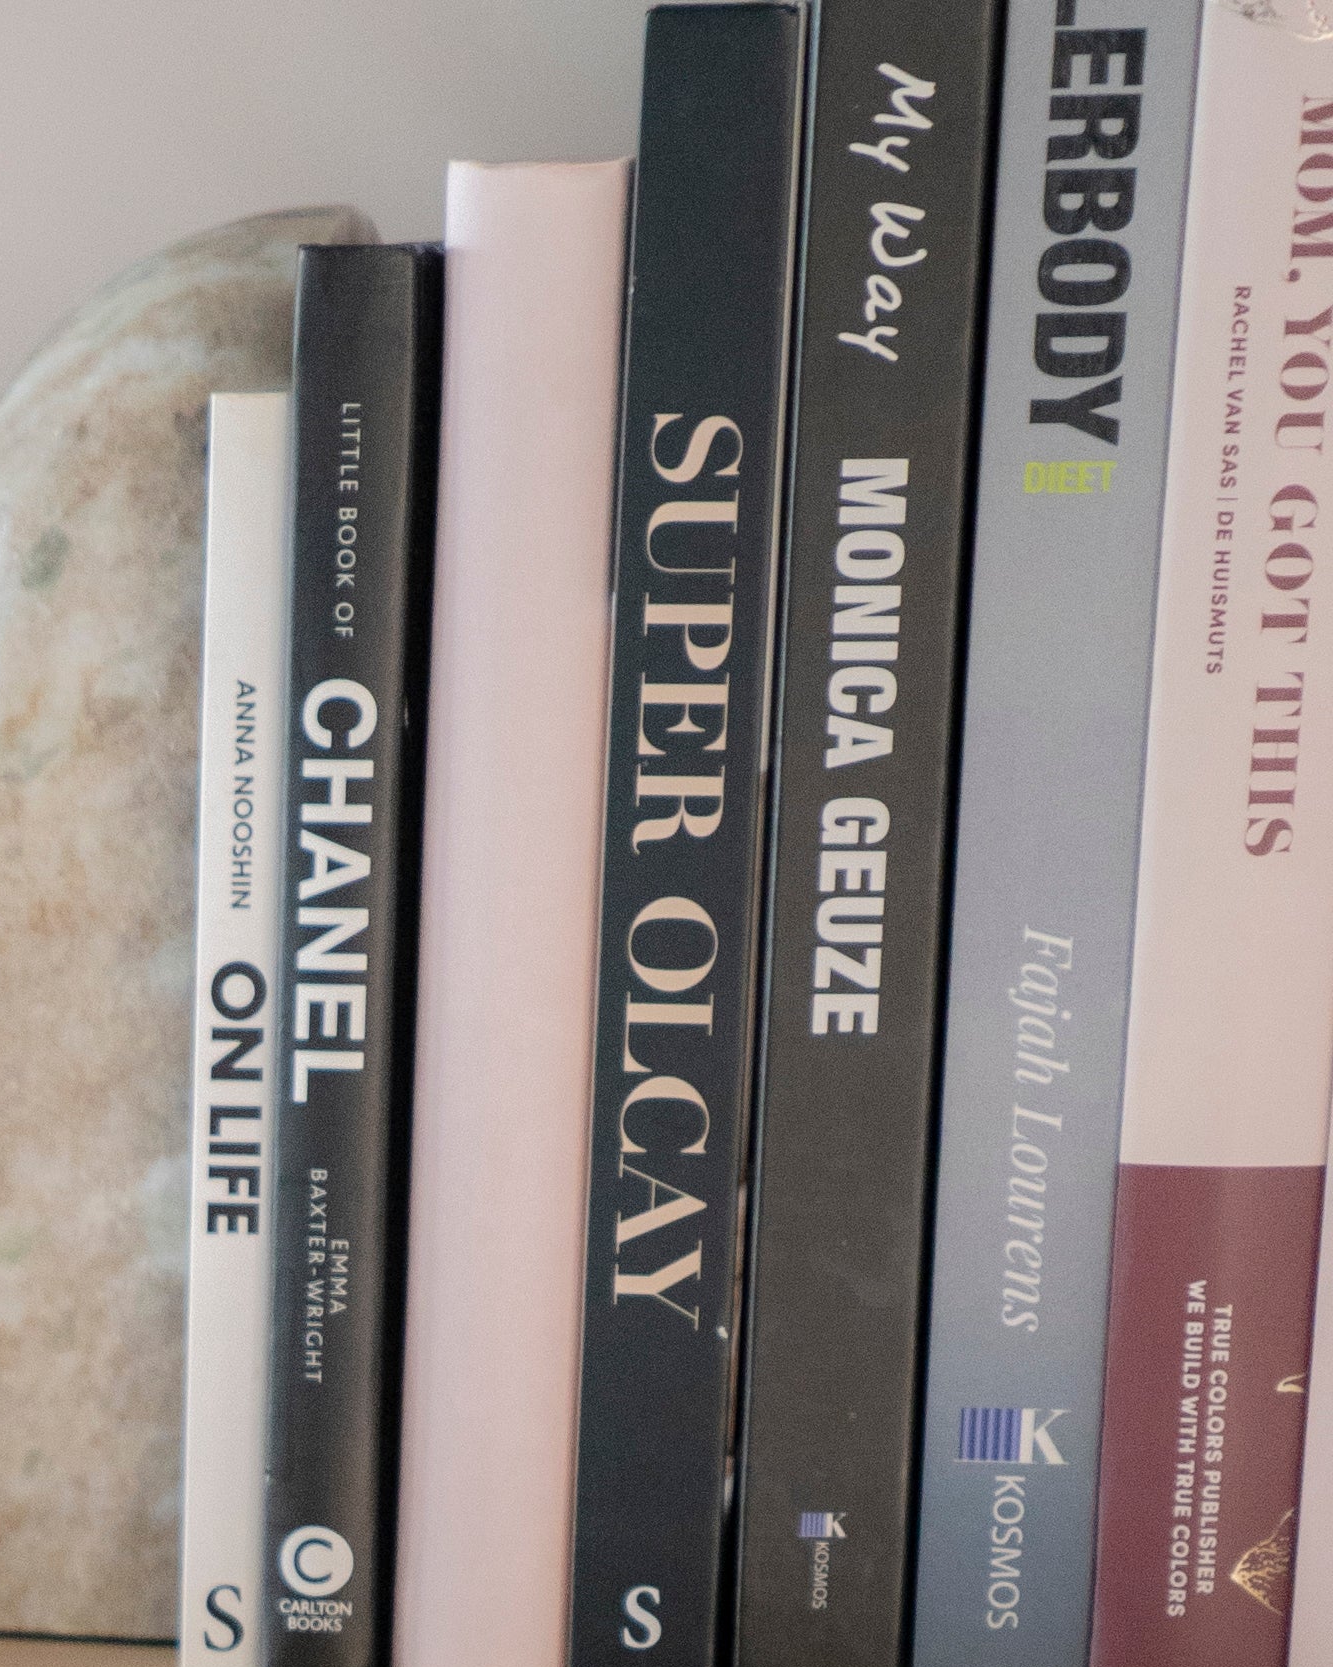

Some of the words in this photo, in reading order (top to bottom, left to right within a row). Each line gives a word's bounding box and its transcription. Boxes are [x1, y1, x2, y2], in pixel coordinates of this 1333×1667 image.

[848, 62, 936, 172] My
[837, 202, 927, 362] Way
[1227, 285, 1252, 381] RACHEL
[1274, 303, 1333, 455] YOU
[338, 402, 361, 492] LITTLE
[1224, 389, 1243, 435] VAN
[1023, 460, 1116, 494] DIEET
[1219, 444, 1240, 489] SAS
[336, 507, 358, 587] BOOK
[1215, 511, 1235, 540] DE
[1260, 484, 1319, 645] GOT
[334, 601, 355, 637] OF
[631, 413, 742, 854] SUPER
[825, 458, 909, 769] MONICA
[1205, 550, 1231, 675] HUISMUTS
[235, 680, 257, 765] ANNA
[1244, 671, 1305, 858] THIS
[230, 775, 254, 910] NOOSHIN
[292, 679, 378, 1103] CHANEL
[811, 797, 890, 1035] GEUZE
[210, 961, 267, 1082] ON
[1010, 926, 1073, 1085] Fajah
[613, 896, 718, 1331] OLCAY
[206, 1105, 262, 1234] LIFE
[1002, 1103, 1063, 1333] Lourens
[305, 1168, 328, 1383] BAXTER-WRIGHT
[329, 1239, 350, 1315] EMMA
[1187, 1280, 1207, 1314] WE
[1182, 1321, 1204, 1389] BUILD
[1209, 1304, 1233, 1362] TRUE
[1178, 1395, 1199, 1454] WITH
[1203, 1369, 1229, 1463] COLORS
[1173, 1460, 1195, 1517] TRUE
[1194, 1470, 1222, 1595] PUBLISHER
[812, 1541, 830, 1610] KOSMOS
[986, 1474, 1026, 1629] KOSMOS
[1167, 1524, 1191, 1617] COLORS
[279, 1599, 353, 1616] CARLTON
[287, 1616, 343, 1633] BOOKS
